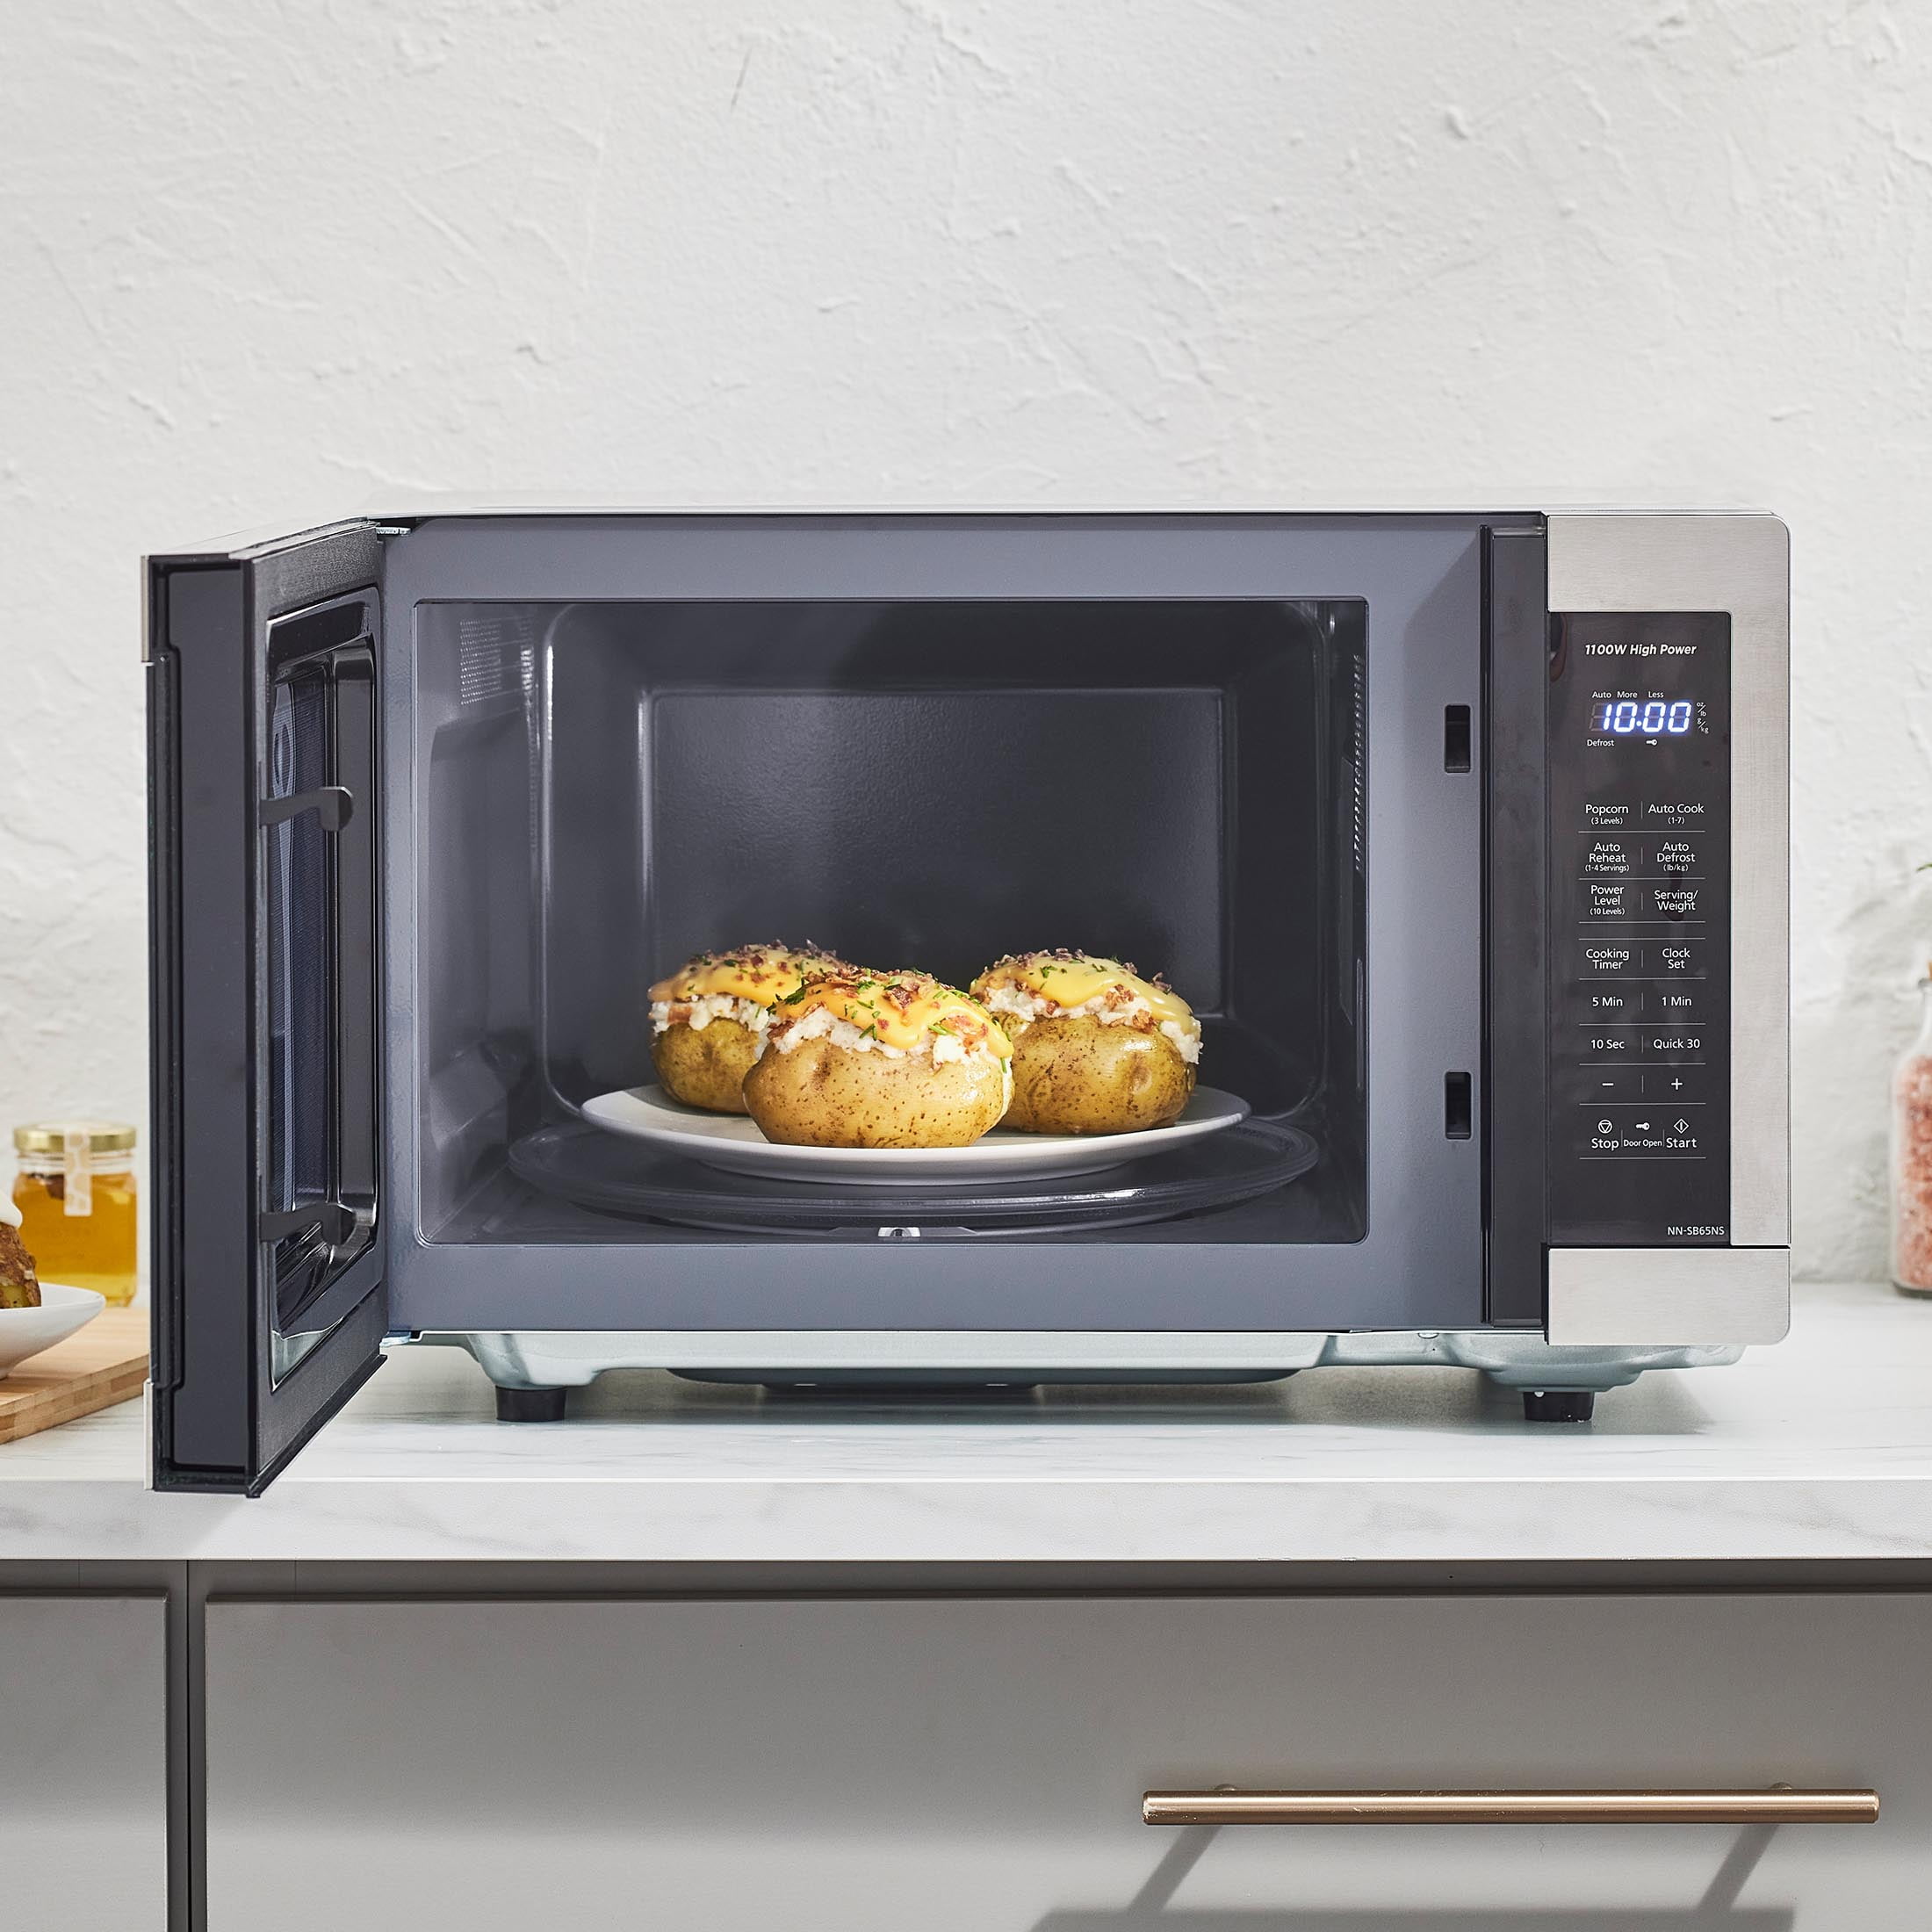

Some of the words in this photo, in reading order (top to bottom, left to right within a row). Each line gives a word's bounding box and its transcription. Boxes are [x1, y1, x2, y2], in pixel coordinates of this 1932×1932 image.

[1585, 645, 1626, 655] 1100W
[1630, 645, 1656, 656] High
[1660, 645, 1697, 654] Power
[1586, 804, 1628, 816] Popcorn
[1648, 804, 1675, 813] Auto
[1677, 804, 1704, 813] Cook
[1663, 842, 1689, 851] Auto
[1590, 854, 1626, 862] Reheat
[1657, 853, 1695, 862] Defrost
[1591, 885, 1624, 894] Power
[1654, 890, 1698, 901] Serving/
[1595, 896, 1620, 905] Level
[1657, 901, 1696, 912] Weight
[1586, 948, 1629, 961] Cooking
[1662, 948, 1690, 957] Clock
[1593, 960, 1623, 969] Timer
[1668, 960, 1685, 969] Set
[1592, 998, 1598, 1006] 5
[1603, 997, 1623, 1006] Min
[1662, 997, 1666, 1006] 1
[1671, 997, 1692, 1006] Min
[1591, 1040, 1603, 1049] 10
[1607, 1040, 1625, 1049] Sec
[1654, 1039, 1684, 1049] Quick
[1687, 1039, 1700, 1049] 30
[1591, 1138, 1618, 1150] Stop
[1667, 1138, 1697, 1148] Start
[1668, 1227, 1725, 1236] NN-SB65NS
